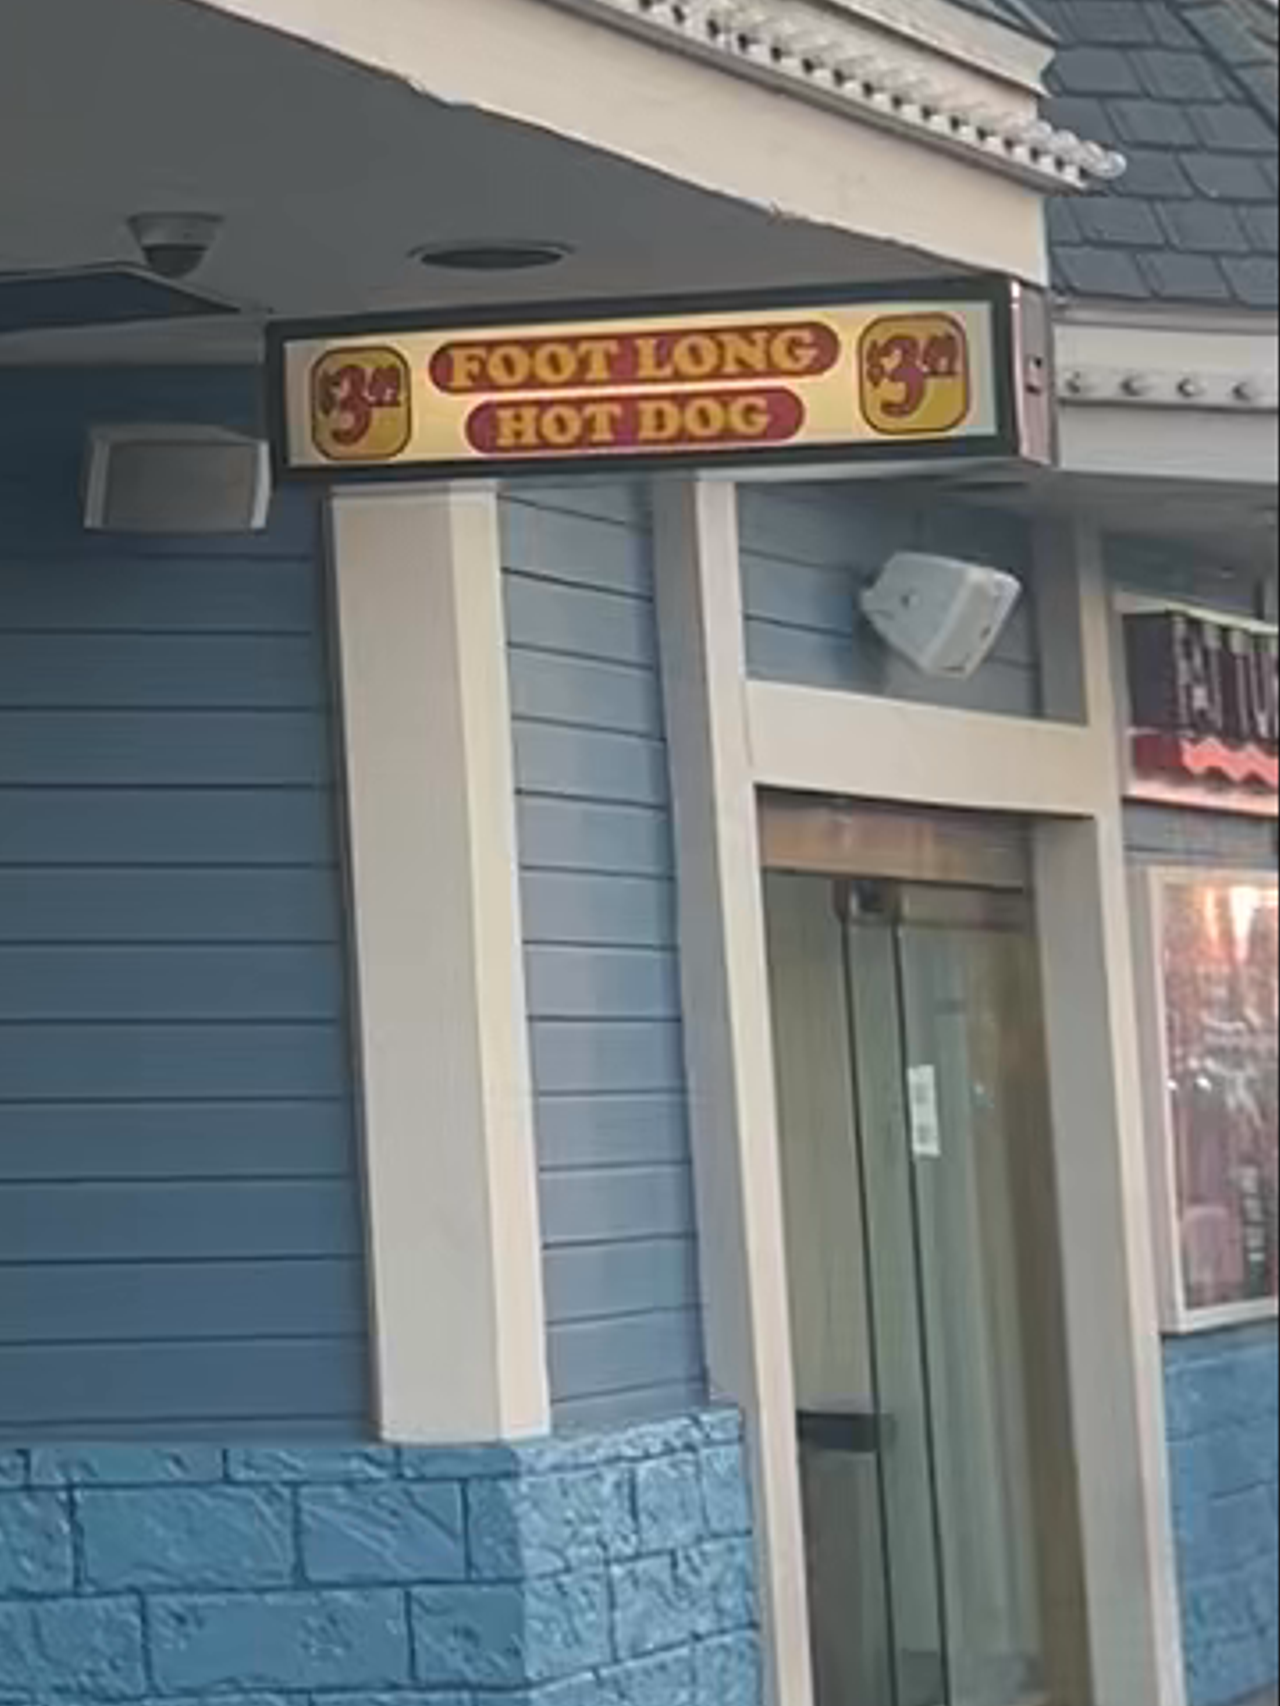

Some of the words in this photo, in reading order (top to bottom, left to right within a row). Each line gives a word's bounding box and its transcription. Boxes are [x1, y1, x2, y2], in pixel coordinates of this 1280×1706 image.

[450, 342, 621, 388] FOOT
[635, 330, 820, 380] LONG
[496, 404, 614, 447] HOT
[645, 394, 772, 442] DOG
